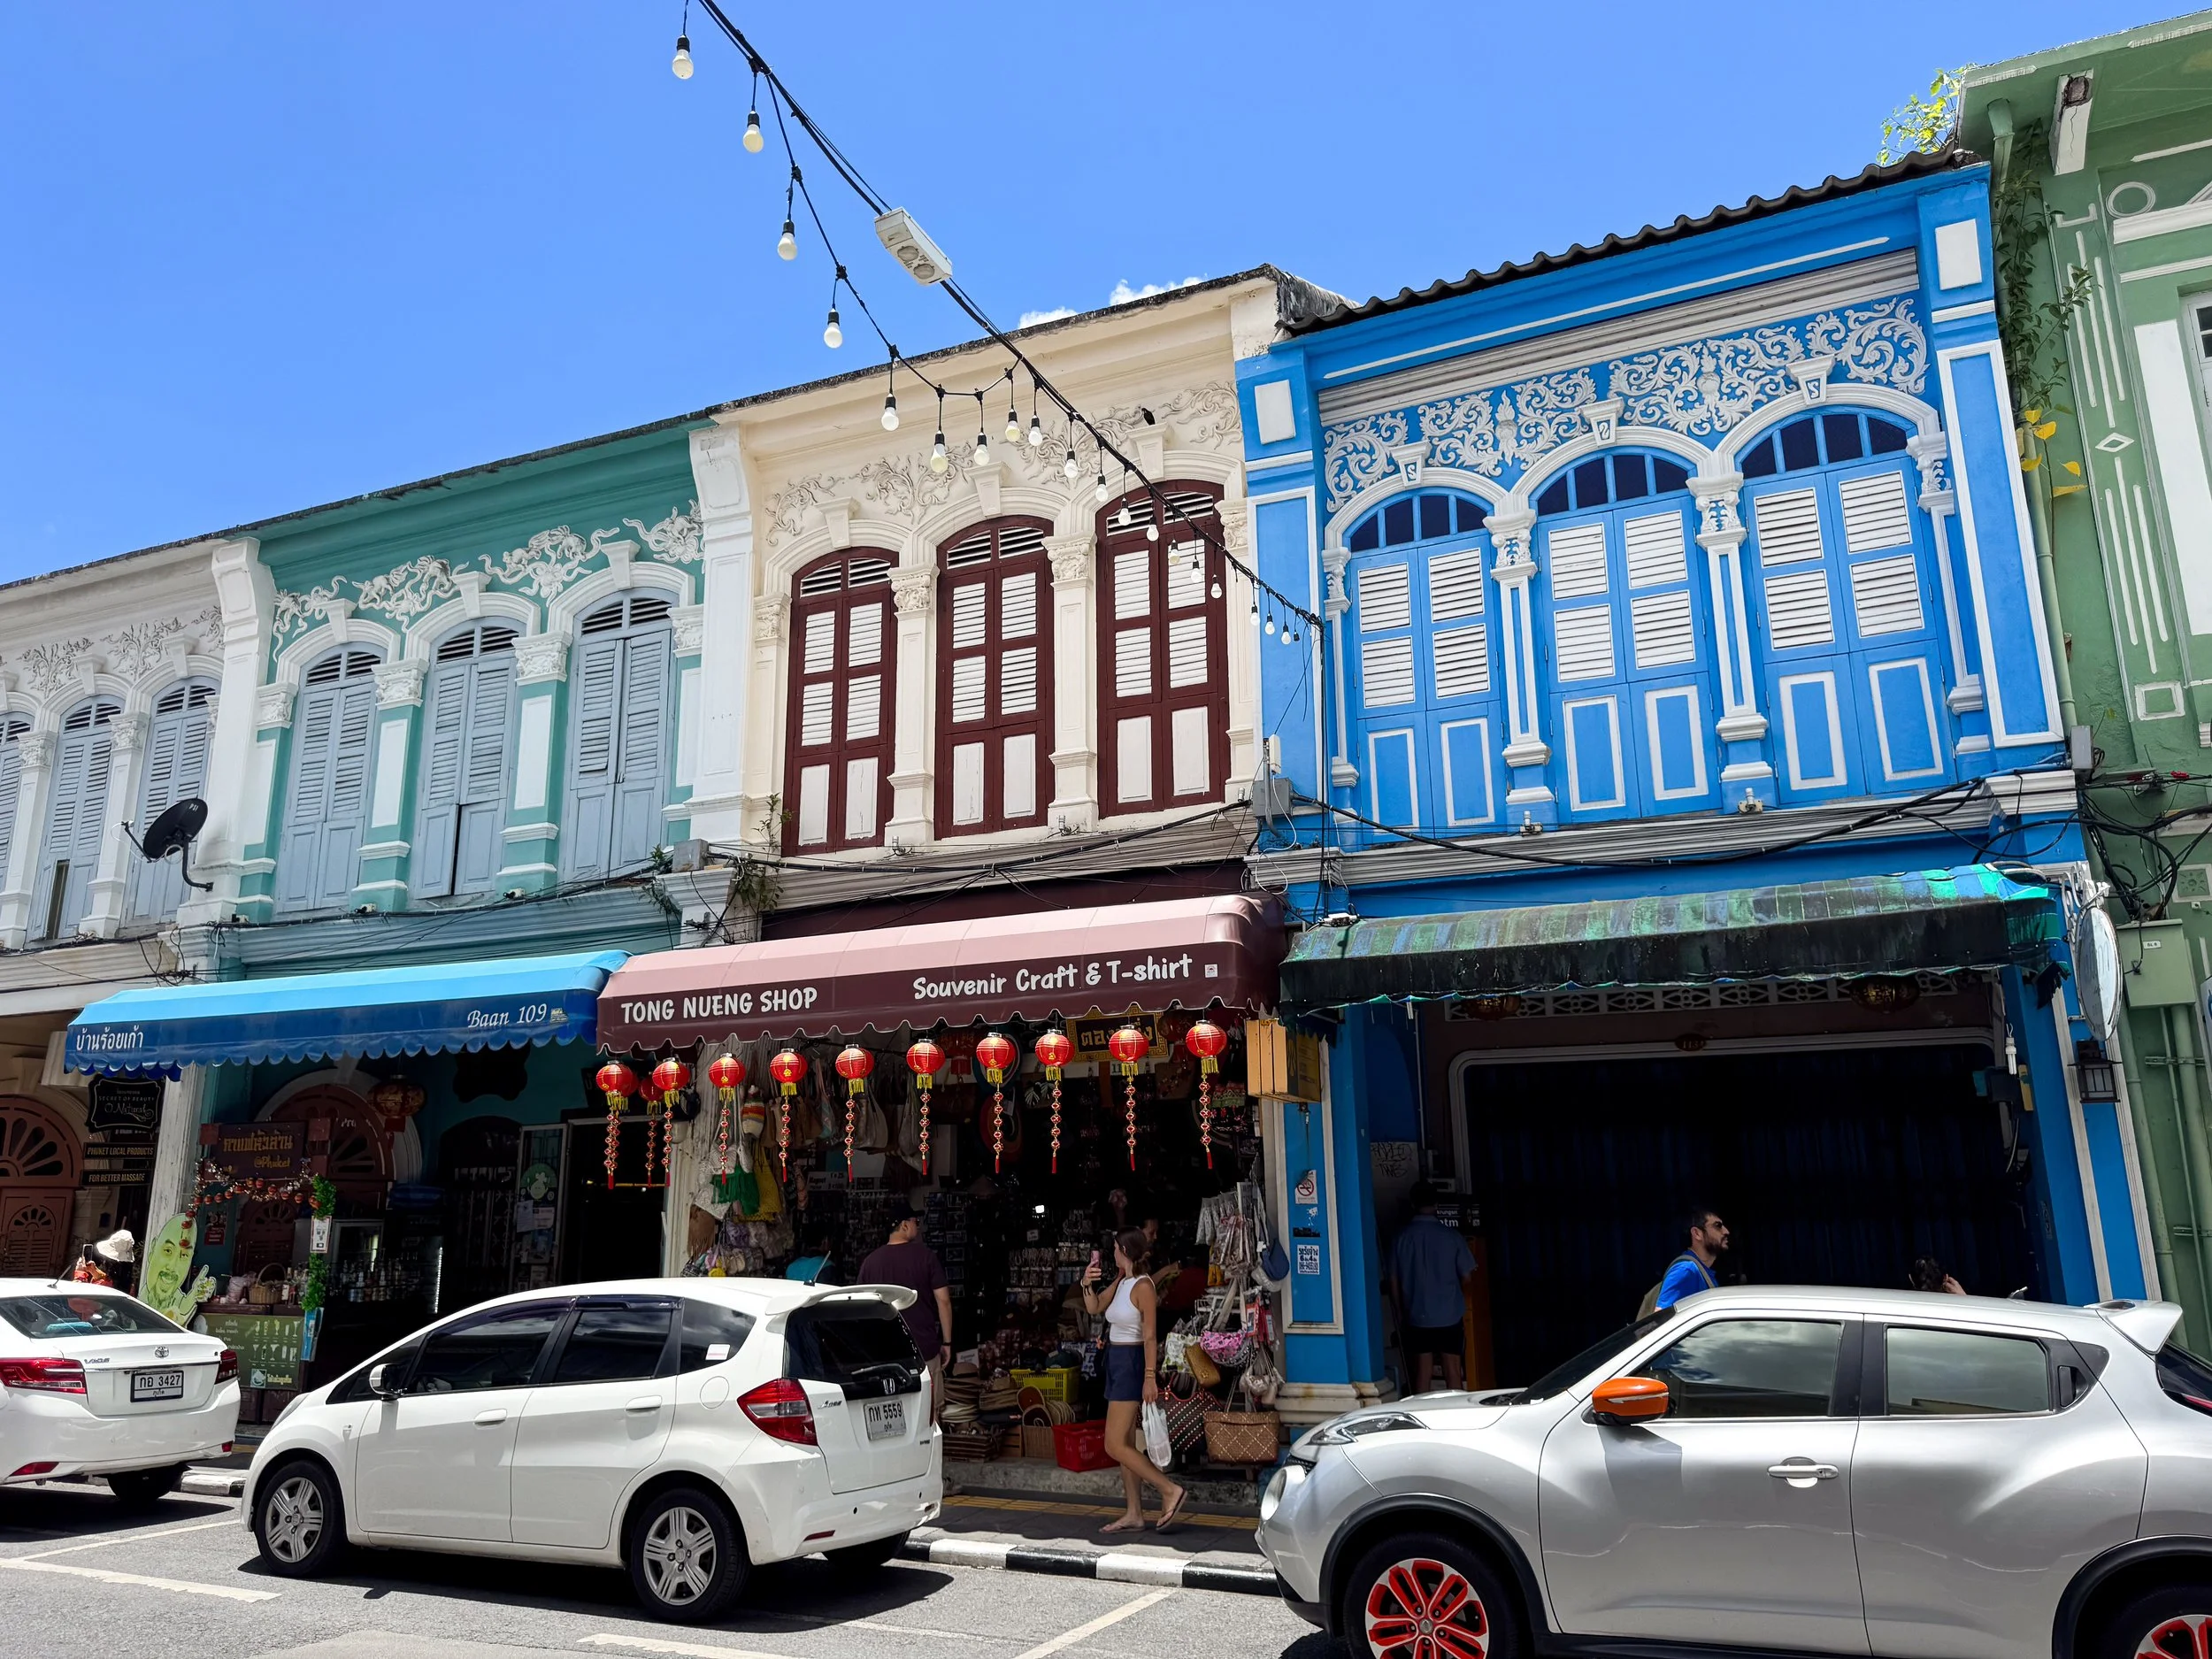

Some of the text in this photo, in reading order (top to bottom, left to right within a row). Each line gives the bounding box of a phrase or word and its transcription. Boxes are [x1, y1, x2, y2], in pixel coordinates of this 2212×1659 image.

[188, 803, 199, 812] PSI
[912, 953, 1193, 1000] Souvenir Craft & T-shirt
[620, 987, 818, 1024] TONG NUENG SHOP
[467, 1010, 510, 1028] Baan
[517, 1002, 547, 1024] 109
[76, 1025, 143, 1051] บ้านร้อยเก้า
[87, 1147, 154, 1156] PHUKET LOCAL PRODUCTS
[253, 1155, 291, 1169] @Phuket
[88, 1172, 146, 1183] FOR BETTER MASSAGE
[158, 1375, 180, 1386] 3427
[883, 1402, 902, 1419] 5559
